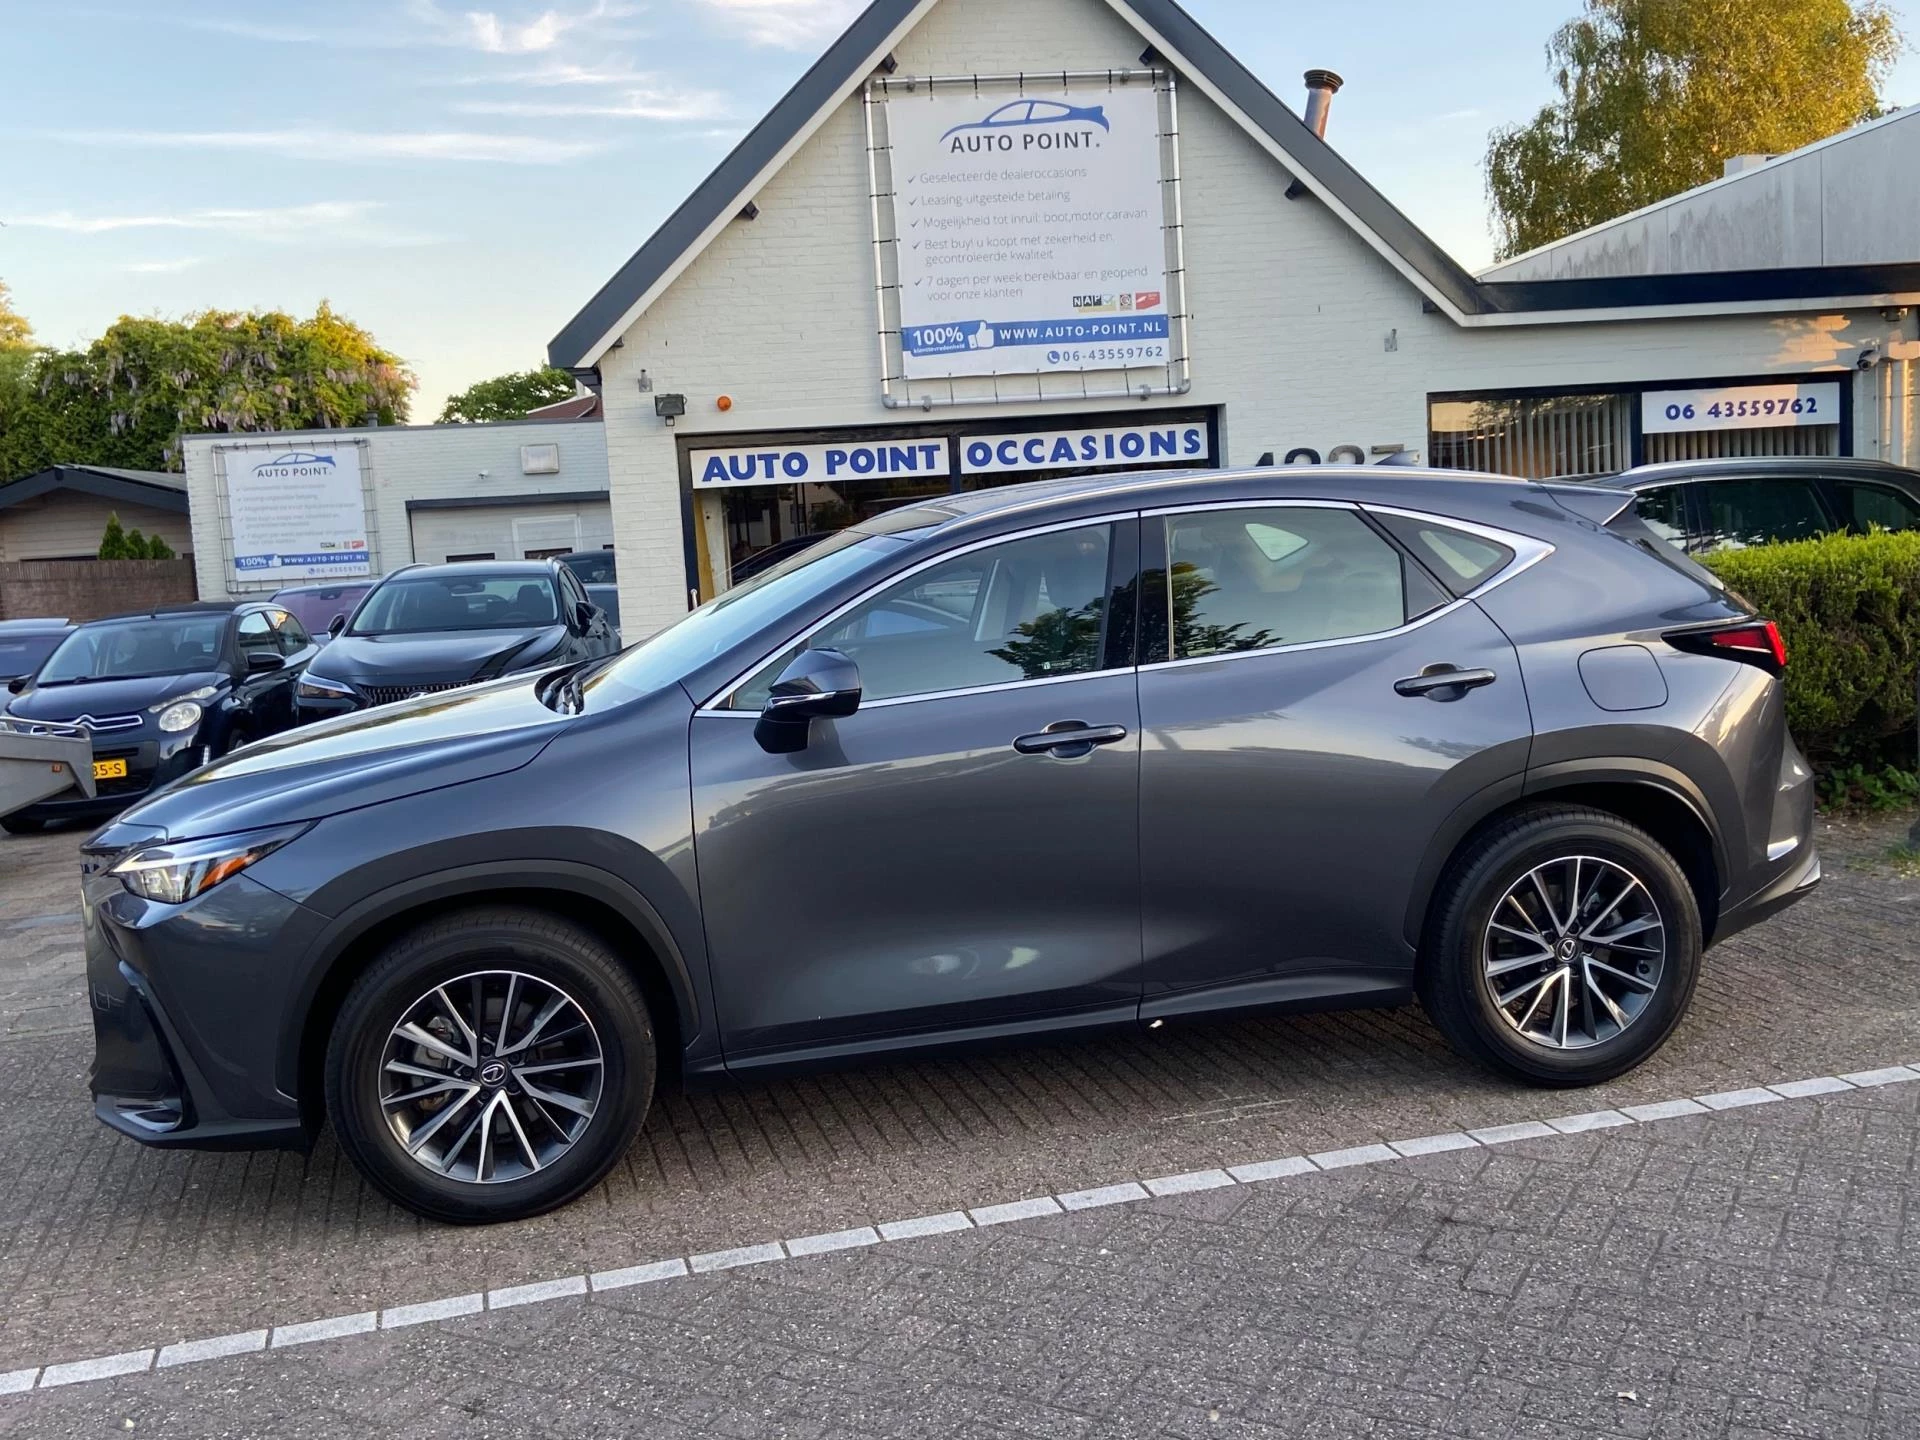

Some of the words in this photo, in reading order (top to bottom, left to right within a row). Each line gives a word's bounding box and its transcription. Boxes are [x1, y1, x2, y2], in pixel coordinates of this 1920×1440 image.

[950, 135, 1013, 153] AUTO
[920, 170, 998, 184] Geselecteerde
[1000, 167, 1088, 180] dealeroccasions
[1028, 190, 1071, 203] betaling
[924, 214, 990, 230] Mogelijkheid
[993, 214, 1008, 225] tot
[925, 240, 948, 250] Best
[976, 240, 984, 248] u
[987, 237, 1018, 249] koopt
[1020, 235, 1041, 246] met
[1044, 232, 1096, 245] zekerheid
[1099, 232, 1113, 242] en
[925, 250, 1008, 267] gecontroleerde
[1010, 248, 1054, 261] kwaliteit
[927, 276, 934, 286] 7
[936, 275, 970, 288] dagen
[972, 275, 991, 286] per
[993, 271, 1021, 283] week
[1024, 269, 1081, 281] bereikbaar
[1084, 271, 1098, 280] en
[1100, 265, 1148, 281] geopend
[928, 291, 952, 301] voor
[954, 290, 981, 300] onze
[984, 287, 1023, 298] klanten
[913, 326, 964, 346] 100%
[1000, 321, 1162, 340] WWW.AUTO-POINT.NL
[1063, 346, 1163, 362] 06-43559762
[1665, 404, 1695, 420] 06
[1707, 397, 1817, 418] 43559762
[702, 452, 809, 482] AUTO
[826, 444, 940, 475] POINT
[967, 429, 1201, 467] OCCASIONS
[257, 468, 289, 478] AUTO
[240, 556, 267, 567] 100%
